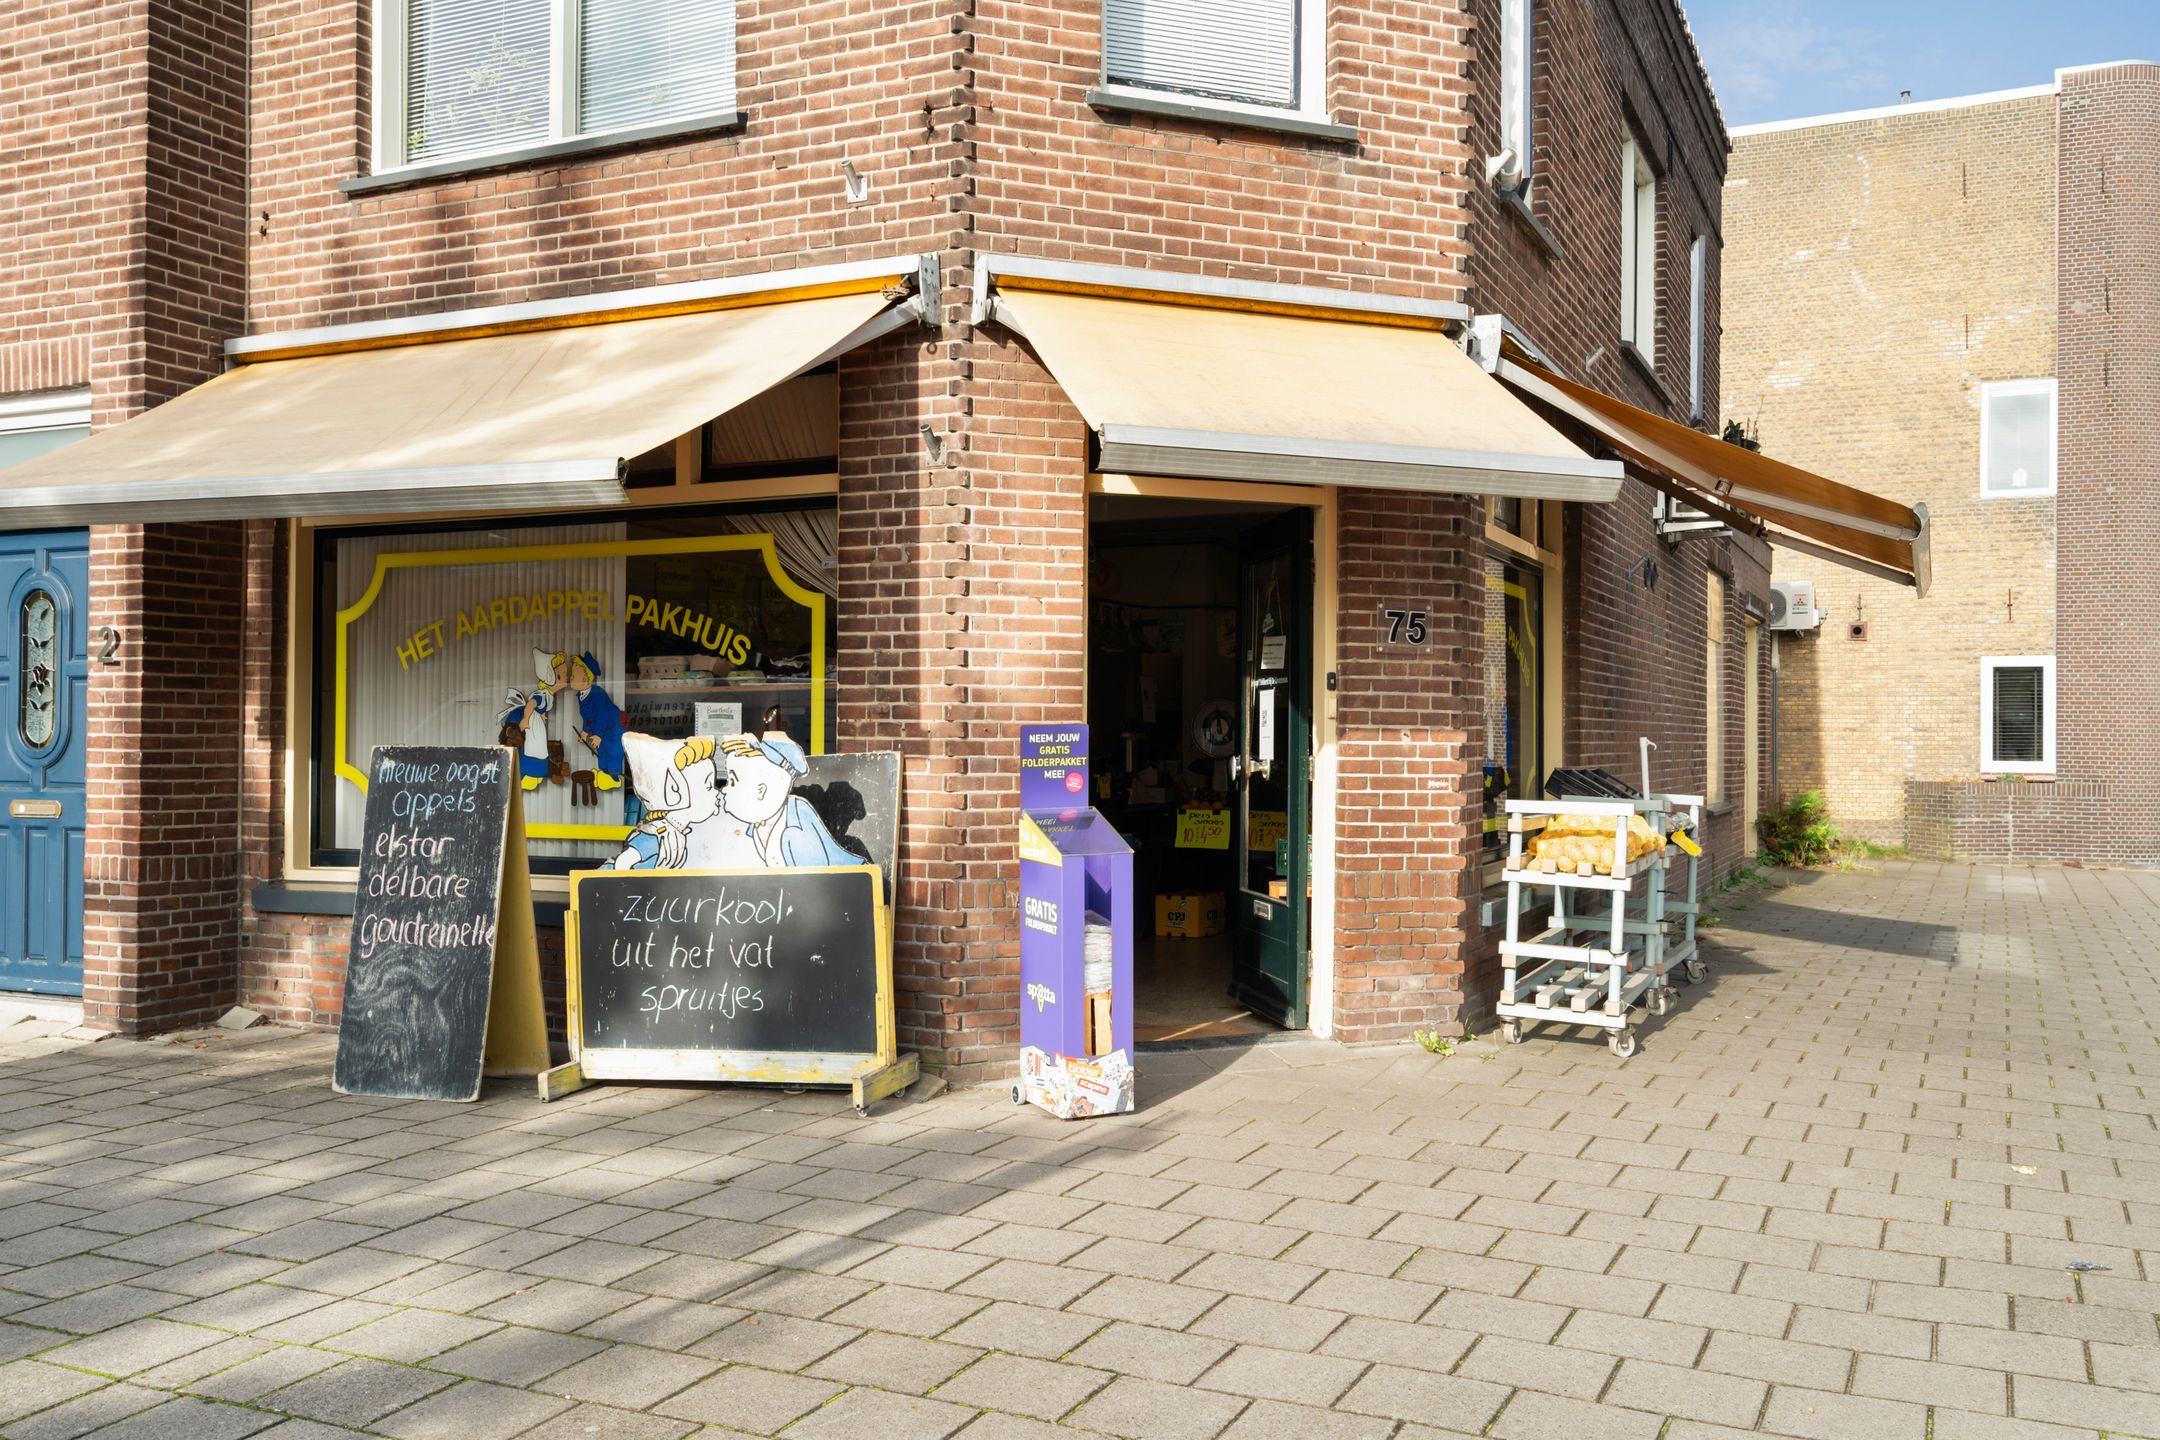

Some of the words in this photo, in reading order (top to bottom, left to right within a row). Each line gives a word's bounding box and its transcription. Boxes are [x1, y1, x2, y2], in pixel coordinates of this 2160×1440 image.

[97, 626, 114, 663] 2
[395, 619, 445, 671] HET
[455, 591, 616, 641] AARDAPPEL
[625, 594, 751, 666] PAKHUIS
[1385, 609, 1427, 646] 75
[1029, 733, 1054, 743] NEEM
[1055, 733, 1080, 743] JOUW
[1039, 745, 1071, 755] GRATIS
[378, 757, 440, 785] nieuwe
[446, 759, 500, 793] oogst
[1022, 756, 1087, 767] FOLDERPAKKET
[1044, 769, 1065, 779] MEE!
[392, 788, 476, 829] appels
[375, 824, 456, 858] elstar
[1183, 827, 1195, 844] 10
[368, 863, 470, 899] delbare
[623, 886, 784, 926] zuurkool
[1025, 896, 1058, 923] GRATIS
[612, 932, 656, 968] uit
[669, 931, 715, 969] het
[729, 934, 773, 969] vat
[640, 981, 764, 1025] spruitjes
[1027, 983, 1056, 1010] spotta
